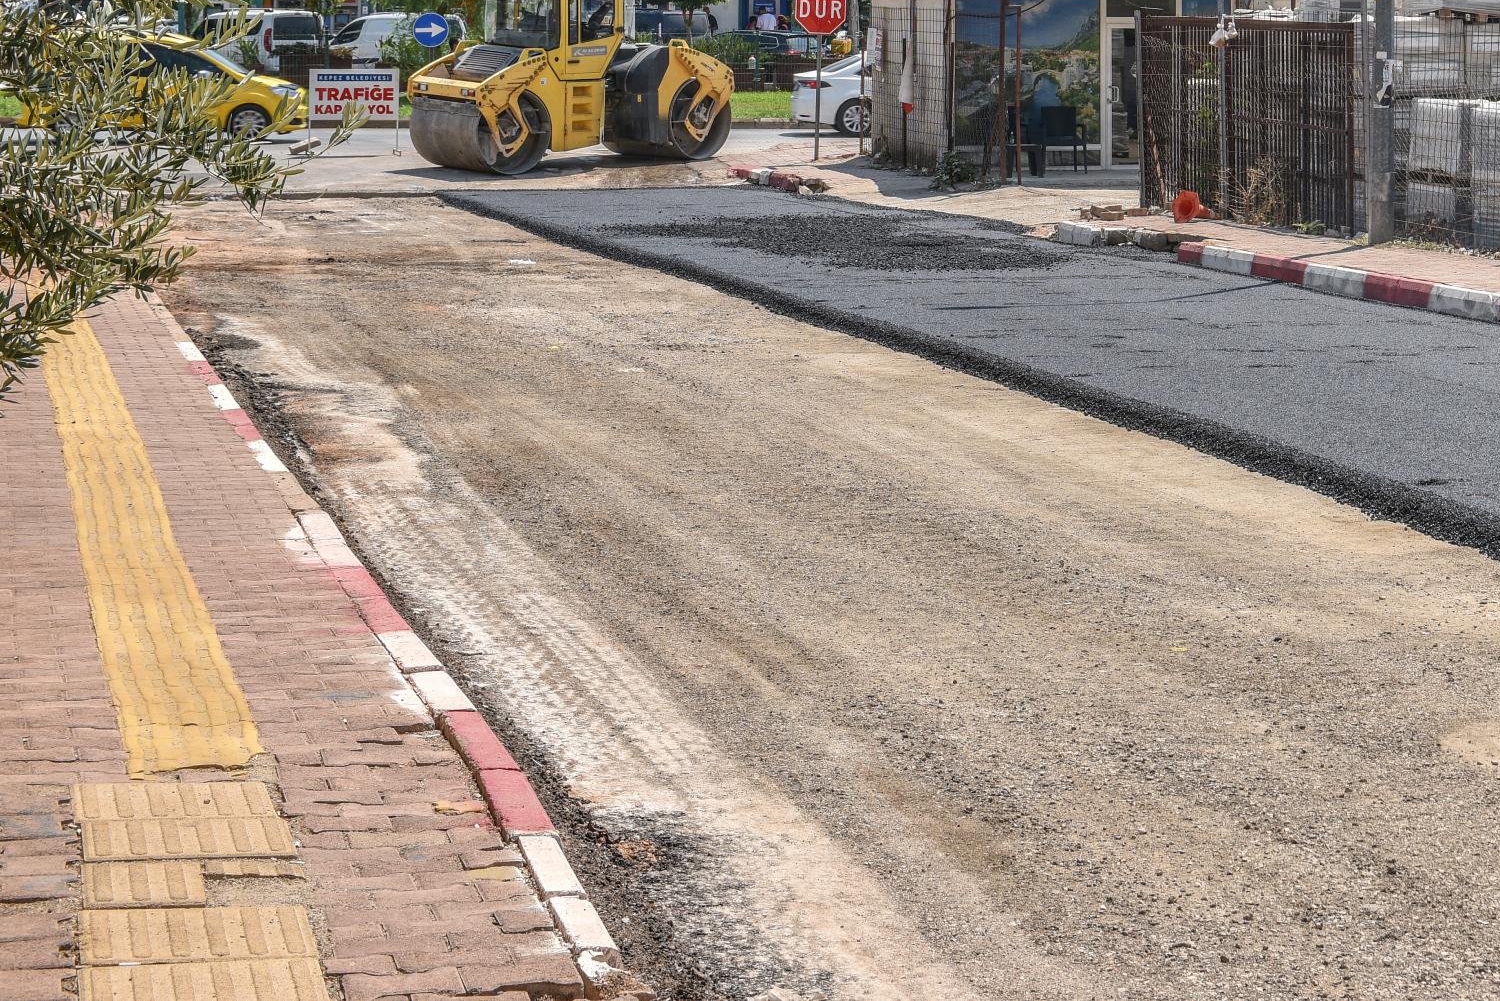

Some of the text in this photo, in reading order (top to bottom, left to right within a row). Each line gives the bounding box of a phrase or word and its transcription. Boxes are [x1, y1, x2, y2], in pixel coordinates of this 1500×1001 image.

[799, 0, 842, 19] DUR
[346, 73, 390, 81] BELEDİYESİ
[368, 104, 394, 115] YOL
